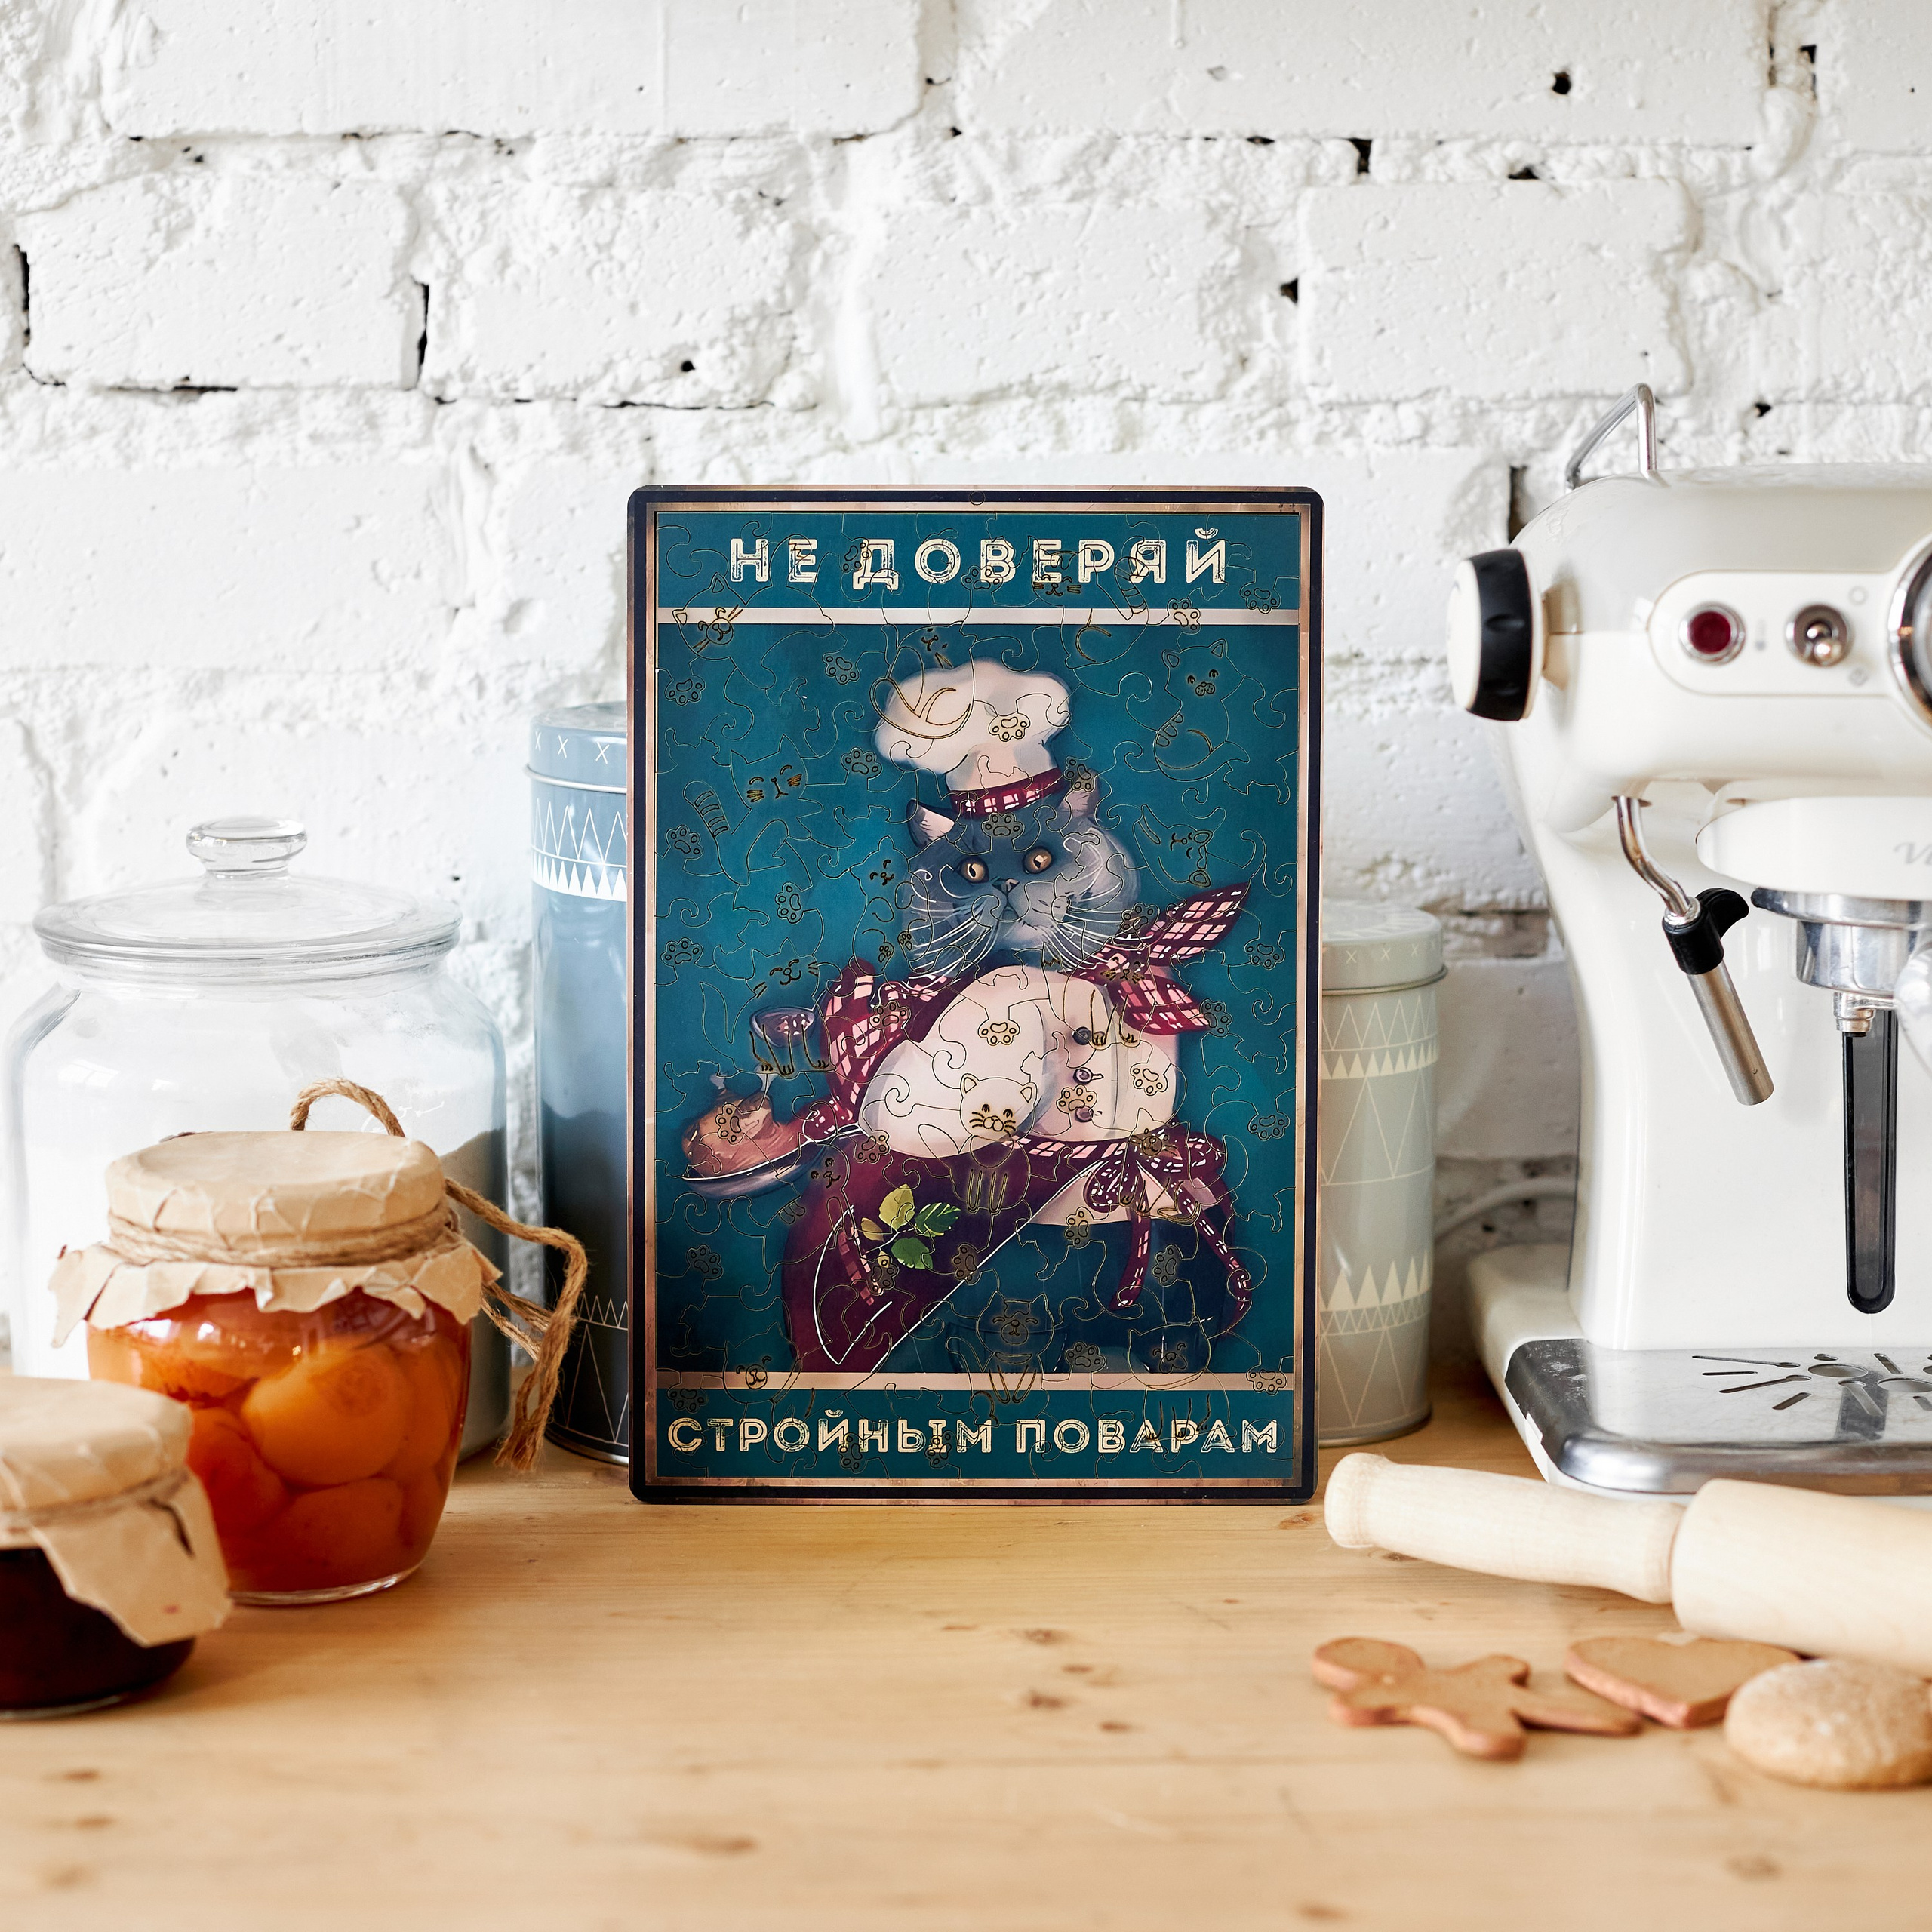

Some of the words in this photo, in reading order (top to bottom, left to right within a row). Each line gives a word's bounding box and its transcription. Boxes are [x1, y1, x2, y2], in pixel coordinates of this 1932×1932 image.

[730, 538, 818, 583] НЕ
[852, 528, 1227, 591] ДОВЕРЯЙ
[667, 1409, 992, 1454] СТРОЙНЫМ
[1015, 1418, 1278, 1454] ПОВАРАМ
